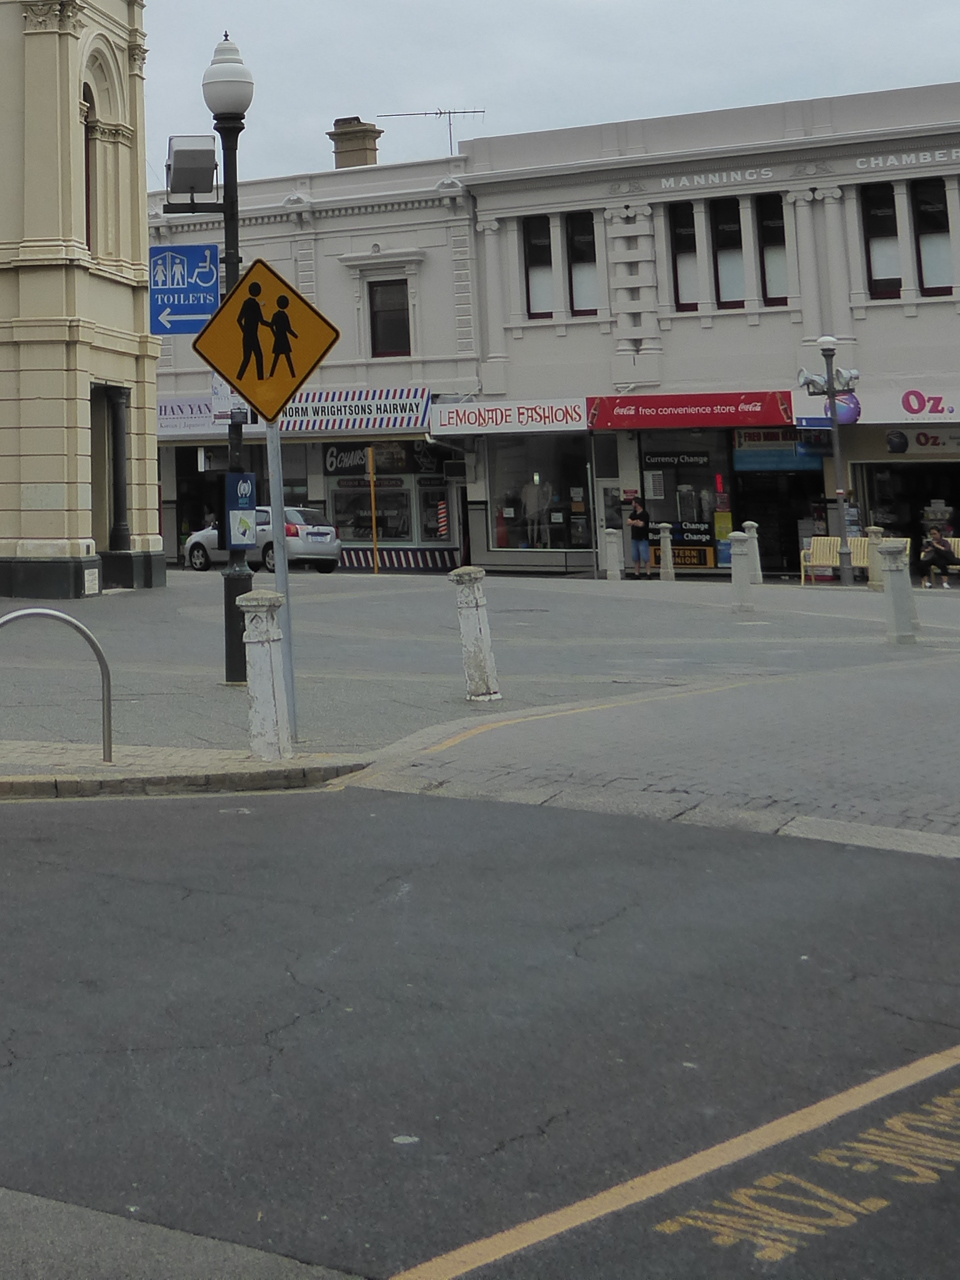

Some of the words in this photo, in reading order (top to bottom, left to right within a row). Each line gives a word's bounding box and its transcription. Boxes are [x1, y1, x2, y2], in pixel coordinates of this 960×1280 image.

[660, 167, 774, 189] MANNING'S
[155, 293, 214, 305] TOILETS
[159, 404, 186, 416] HAN
[282, 406, 309, 418] NORM
[312, 404, 373, 417] WRIGHTSONS
[376, 402, 420, 415] HAIRWAY
[439, 407, 513, 428] LEMONADE
[516, 404, 583, 426] FASHIONS
[639, 406, 657, 416] freo
[658, 405, 712, 416] convenience
[713, 404, 736, 414] store
[326, 446, 337, 471] 6
[337, 449, 367, 468] CHAIRS
[645, 455, 678, 465] Currency
[679, 454, 709, 464] Change
[682, 521, 709, 531] Change
[683, 532, 711, 542] Change
